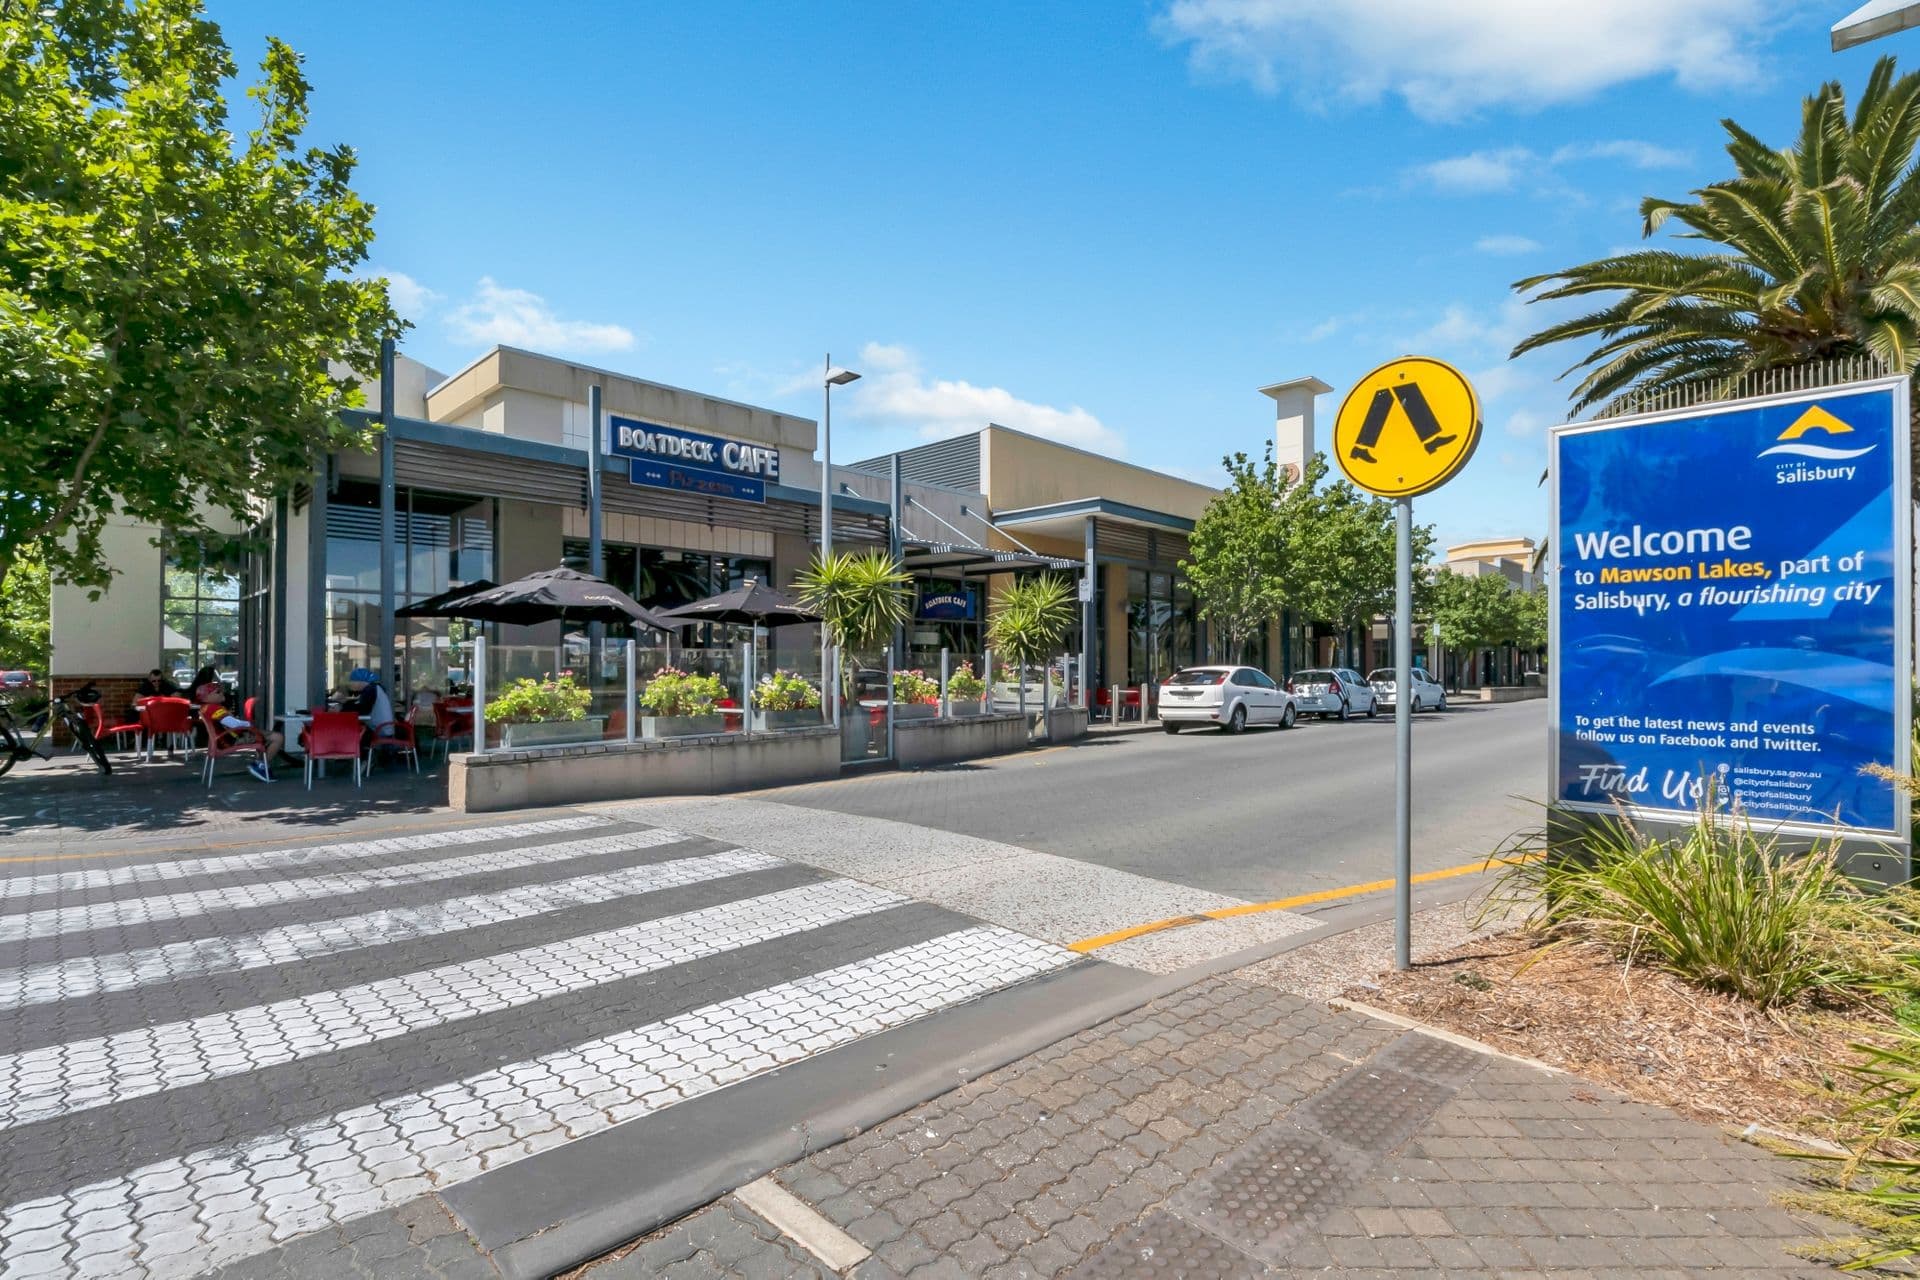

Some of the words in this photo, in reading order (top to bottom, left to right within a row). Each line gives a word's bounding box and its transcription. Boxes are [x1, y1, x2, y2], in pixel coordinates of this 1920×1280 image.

[619, 426, 714, 462] BOATDECK
[723, 443, 778, 476] CAFE
[1776, 466, 1856, 484] Salisbury
[1575, 525, 1752, 560] Welcome
[1575, 569, 1595, 586] to
[1600, 564, 1691, 584] Mawson
[1698, 559, 1772, 581] Lakes,
[1780, 554, 1830, 579] part
[1838, 551, 1864, 572] of
[1574, 592, 1671, 613] Salisbury,
[1678, 592, 1692, 607] a
[1700, 585, 1825, 607] flourishing
[1834, 581, 1881, 605] city
[1576, 715, 1589, 727] To
[1593, 716, 1615, 730] get
[1618, 715, 1641, 728] the
[1645, 716, 1683, 730] latest
[1687, 719, 1725, 732] news
[1730, 719, 1758, 733] and
[1763, 721, 1815, 735] events
[1576, 730, 1616, 743] follow
[1620, 732, 1635, 744] us
[1639, 733, 1656, 745] on
[1660, 733, 1726, 748] Facebook
[1730, 735, 1758, 750] and
[1764, 737, 1821, 752] Twitter.
[1734, 767, 1822, 778] salisbury.sa.gov.au
[1734, 777, 1812, 790] @cityofsalisbury
[1579, 764, 1649, 796] Find
[1662, 769, 1704, 807] Us
[1738, 801, 1812, 812] cityofsalisbury
